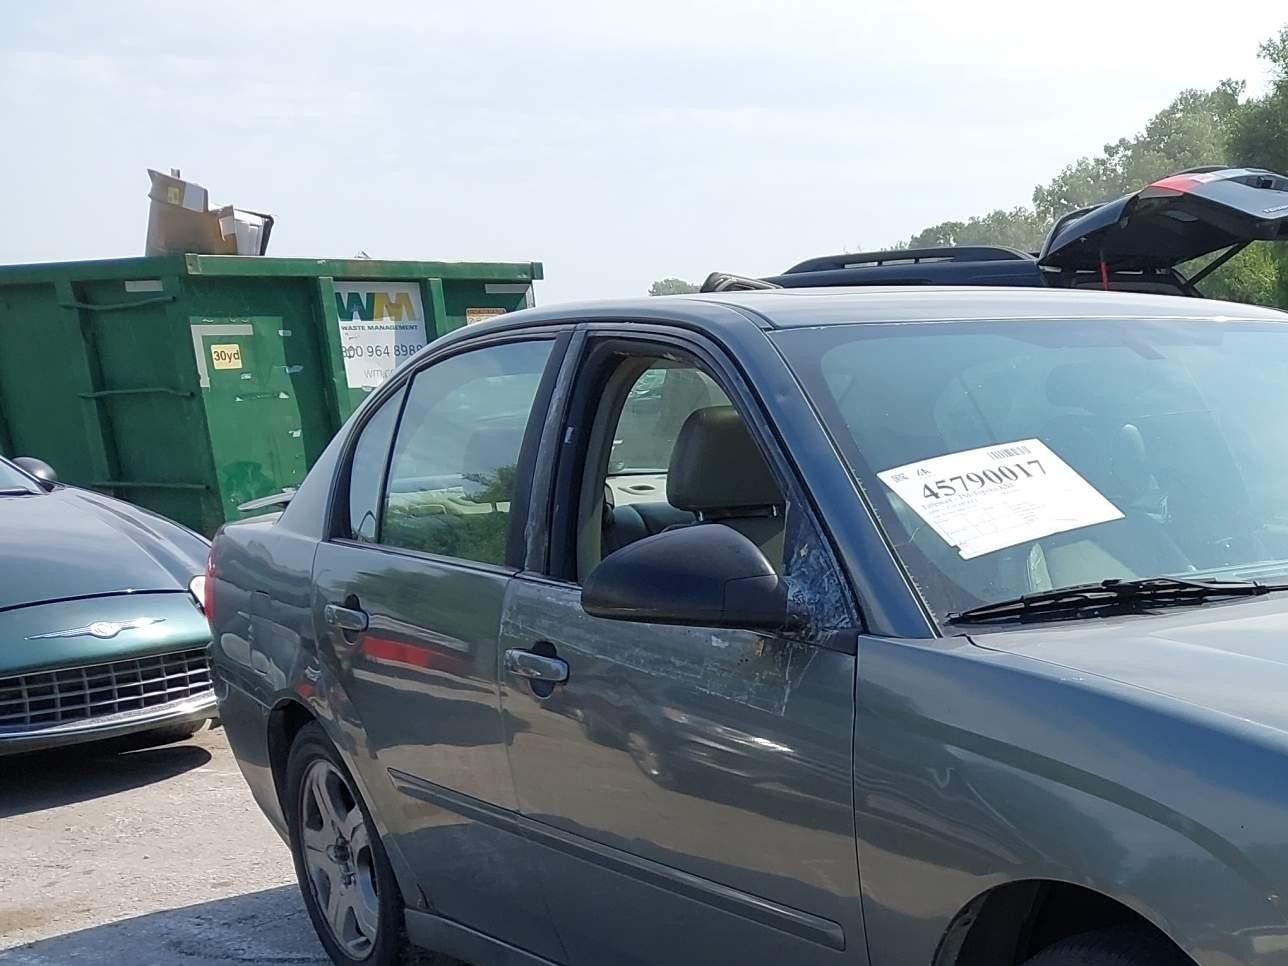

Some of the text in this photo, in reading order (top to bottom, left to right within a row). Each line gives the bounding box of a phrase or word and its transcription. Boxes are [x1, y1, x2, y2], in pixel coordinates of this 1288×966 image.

[335, 292, 416, 322] WM
[213, 349, 240, 363] 30yd
[366, 345, 390, 357] 964
[922, 459, 1047, 499] 45790017
